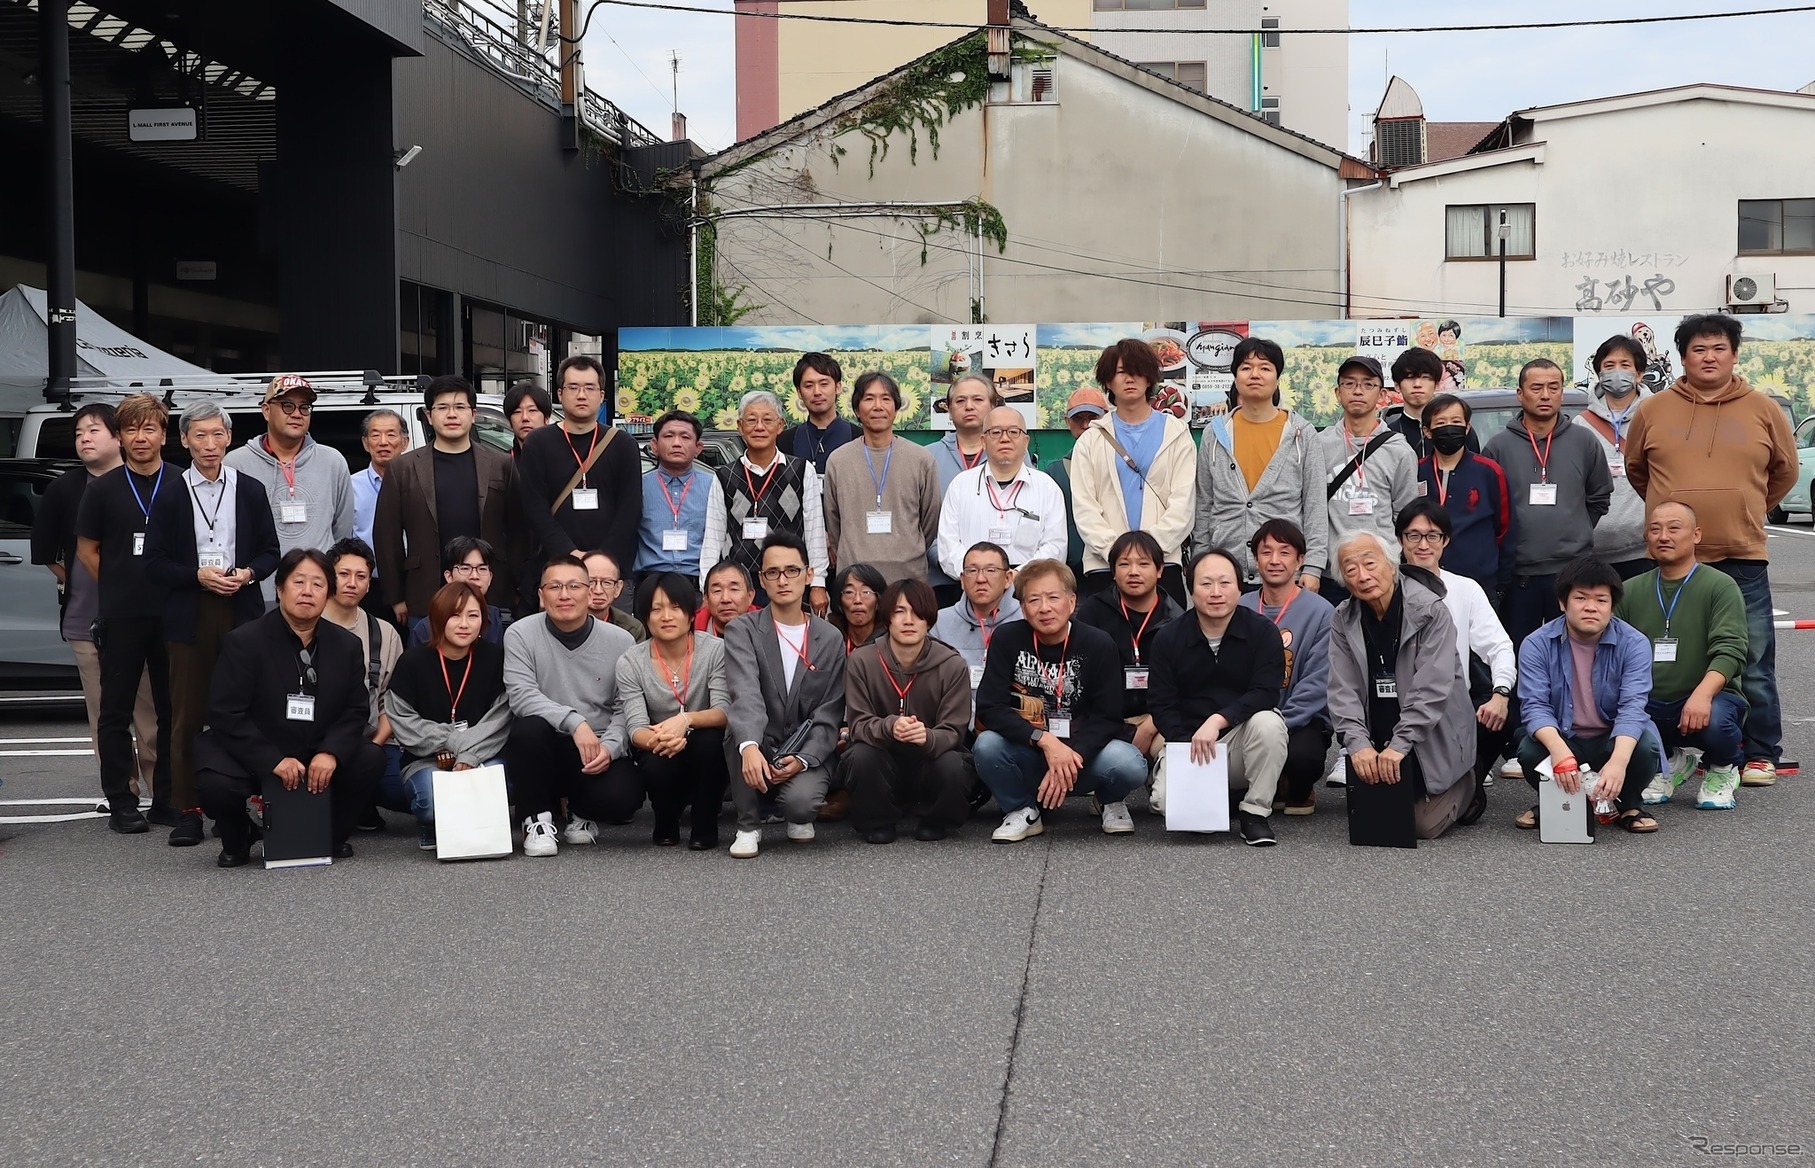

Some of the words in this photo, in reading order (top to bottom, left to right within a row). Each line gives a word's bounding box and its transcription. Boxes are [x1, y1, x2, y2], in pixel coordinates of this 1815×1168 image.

[1561, 248, 1690, 269] お好み焼レストラン
[1575, 273, 1676, 312] 高砂や
[290, 706, 311, 716] 審査員
